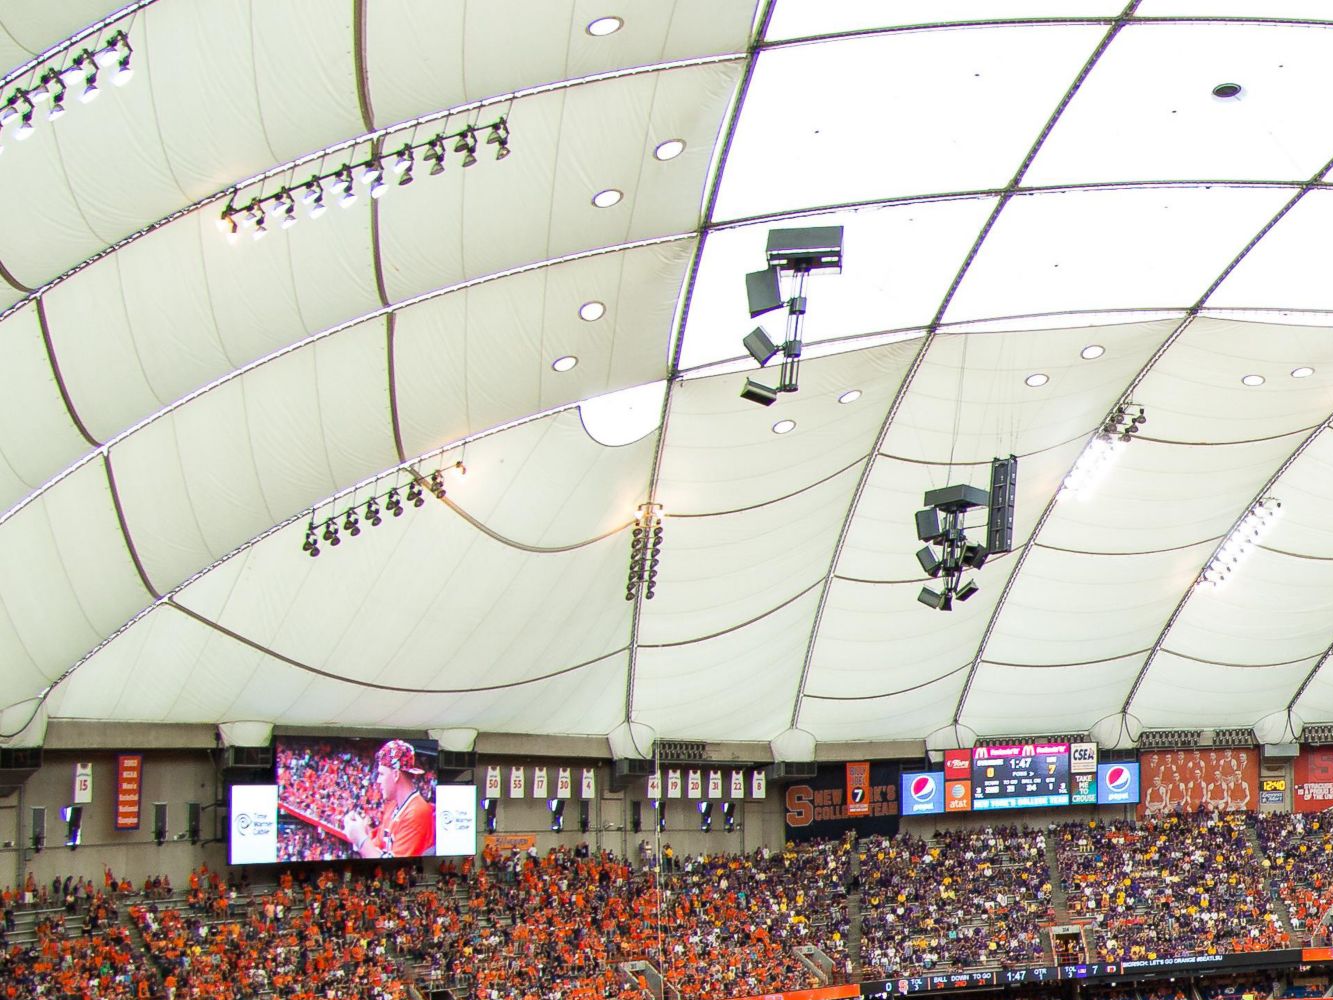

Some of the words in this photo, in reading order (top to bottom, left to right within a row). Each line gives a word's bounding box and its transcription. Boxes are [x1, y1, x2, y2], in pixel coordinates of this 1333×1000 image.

[1073, 748, 1094, 761] CSEA
[1010, 758, 1032, 768] 1:47
[1263, 781, 1286, 790] 12:40
[814, 789, 842, 806] NEW
[854, 789, 863, 802] 7
[786, 785, 814, 827] S
[1007, 971, 1026, 981] 1:47
[1092, 966, 1098, 974] 7
